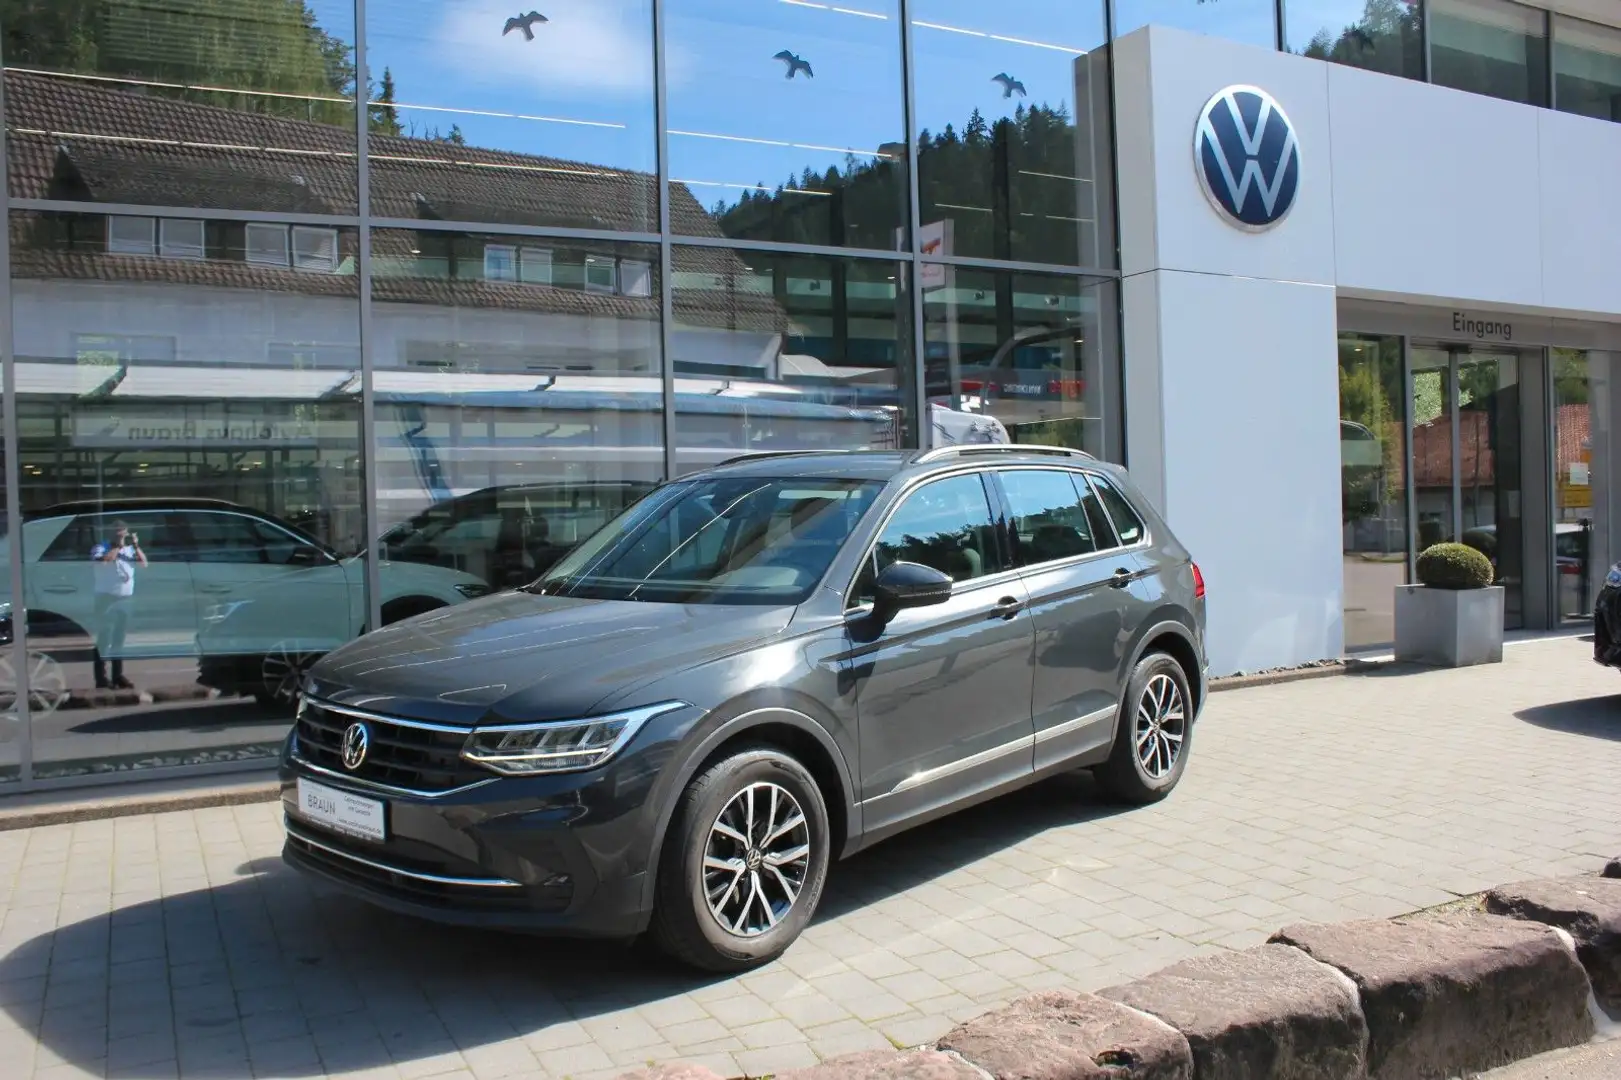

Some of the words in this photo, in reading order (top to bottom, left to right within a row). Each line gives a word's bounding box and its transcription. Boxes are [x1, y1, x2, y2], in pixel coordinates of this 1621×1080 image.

[1195, 84, 1301, 232] VW
[1453, 312, 1512, 340] Eingang
[342, 723, 367, 769] VW
[307, 794, 336, 815] BRAUN
